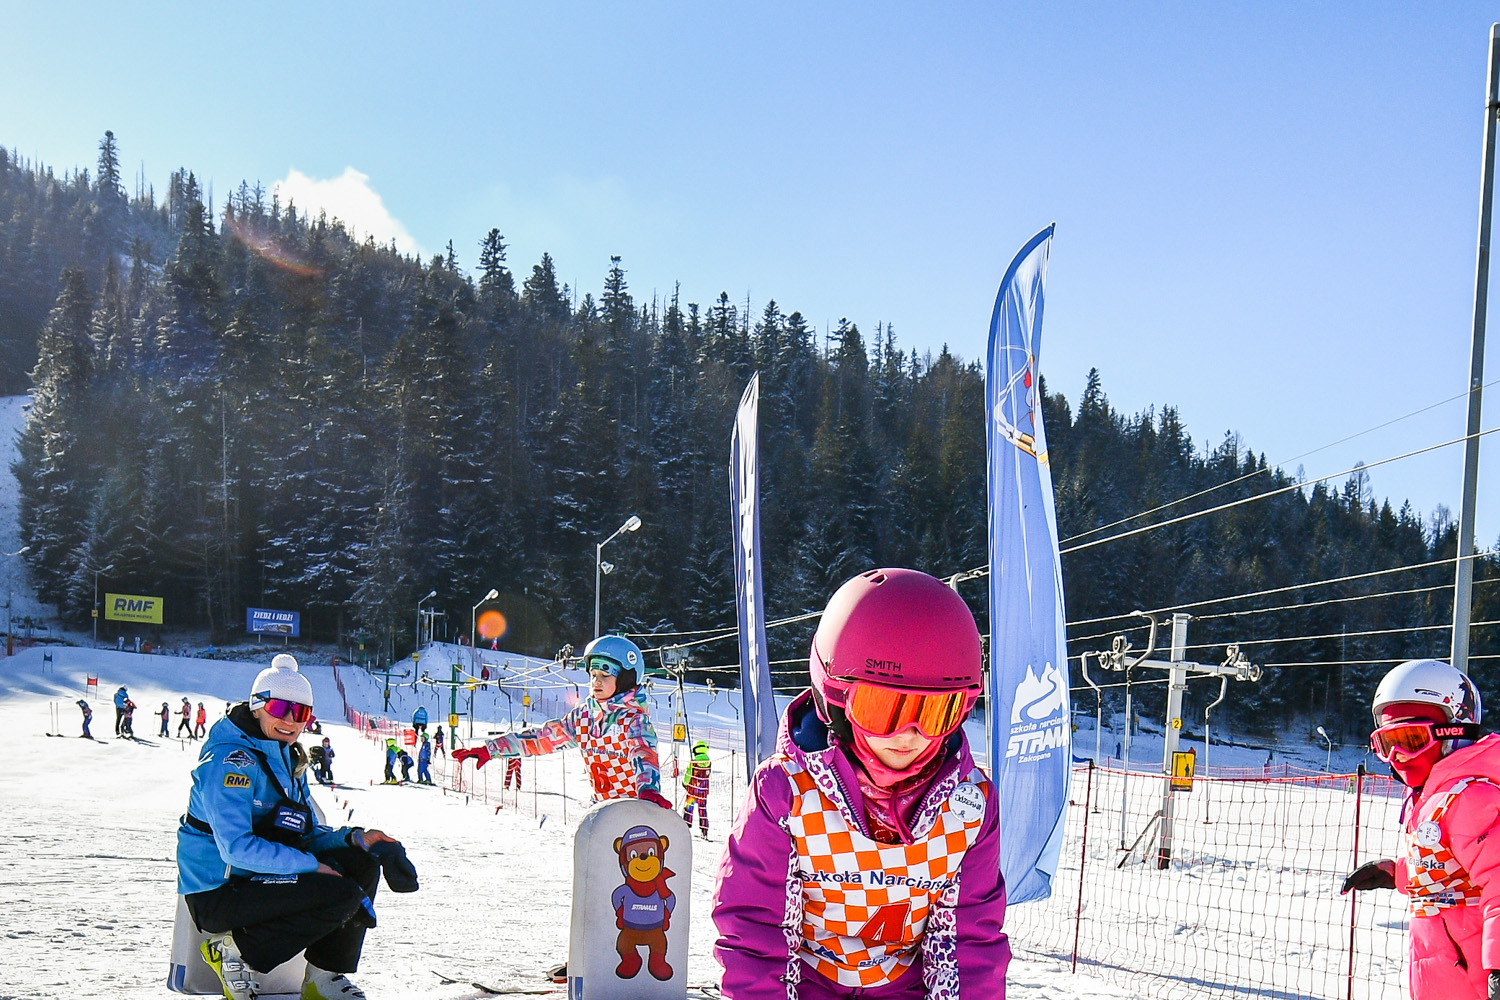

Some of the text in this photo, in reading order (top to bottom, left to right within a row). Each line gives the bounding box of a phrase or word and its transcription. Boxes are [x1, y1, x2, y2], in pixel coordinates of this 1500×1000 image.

[114, 597, 155, 612] RMF
[253, 611, 271, 620] ZJEDZ
[865, 658, 902, 672] SMITH
[1435, 726, 1464, 737] uvex
[1018, 752, 1051, 764] Zakopane
[226, 775, 250, 787] RMF
[590, 761, 611, 793] 6
[800, 869, 951, 891] Szkoła Narciarsk
[854, 901, 912, 942] 4
